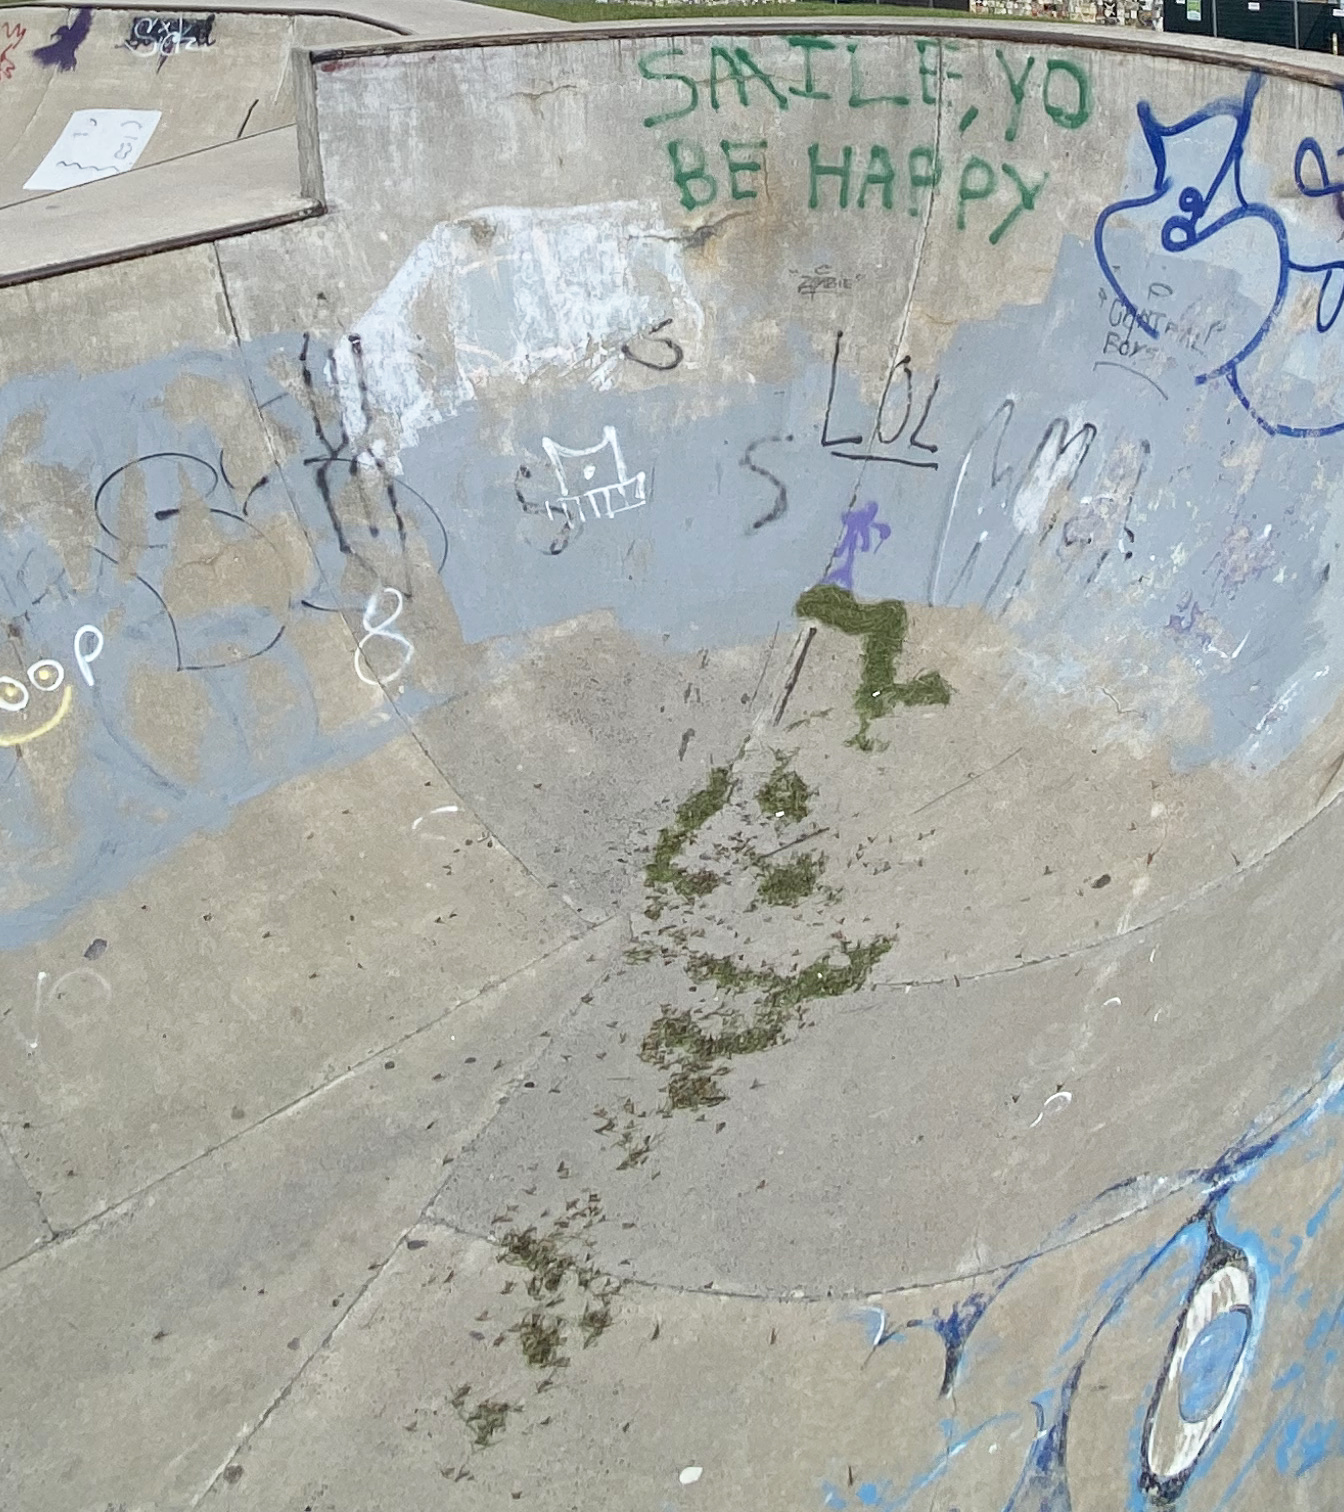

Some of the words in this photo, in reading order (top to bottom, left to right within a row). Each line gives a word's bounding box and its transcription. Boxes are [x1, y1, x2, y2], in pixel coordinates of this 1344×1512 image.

[666, 139, 769, 211] BE
[807, 143, 1049, 245] HAPPY
[821, 330, 939, 453] LOL
